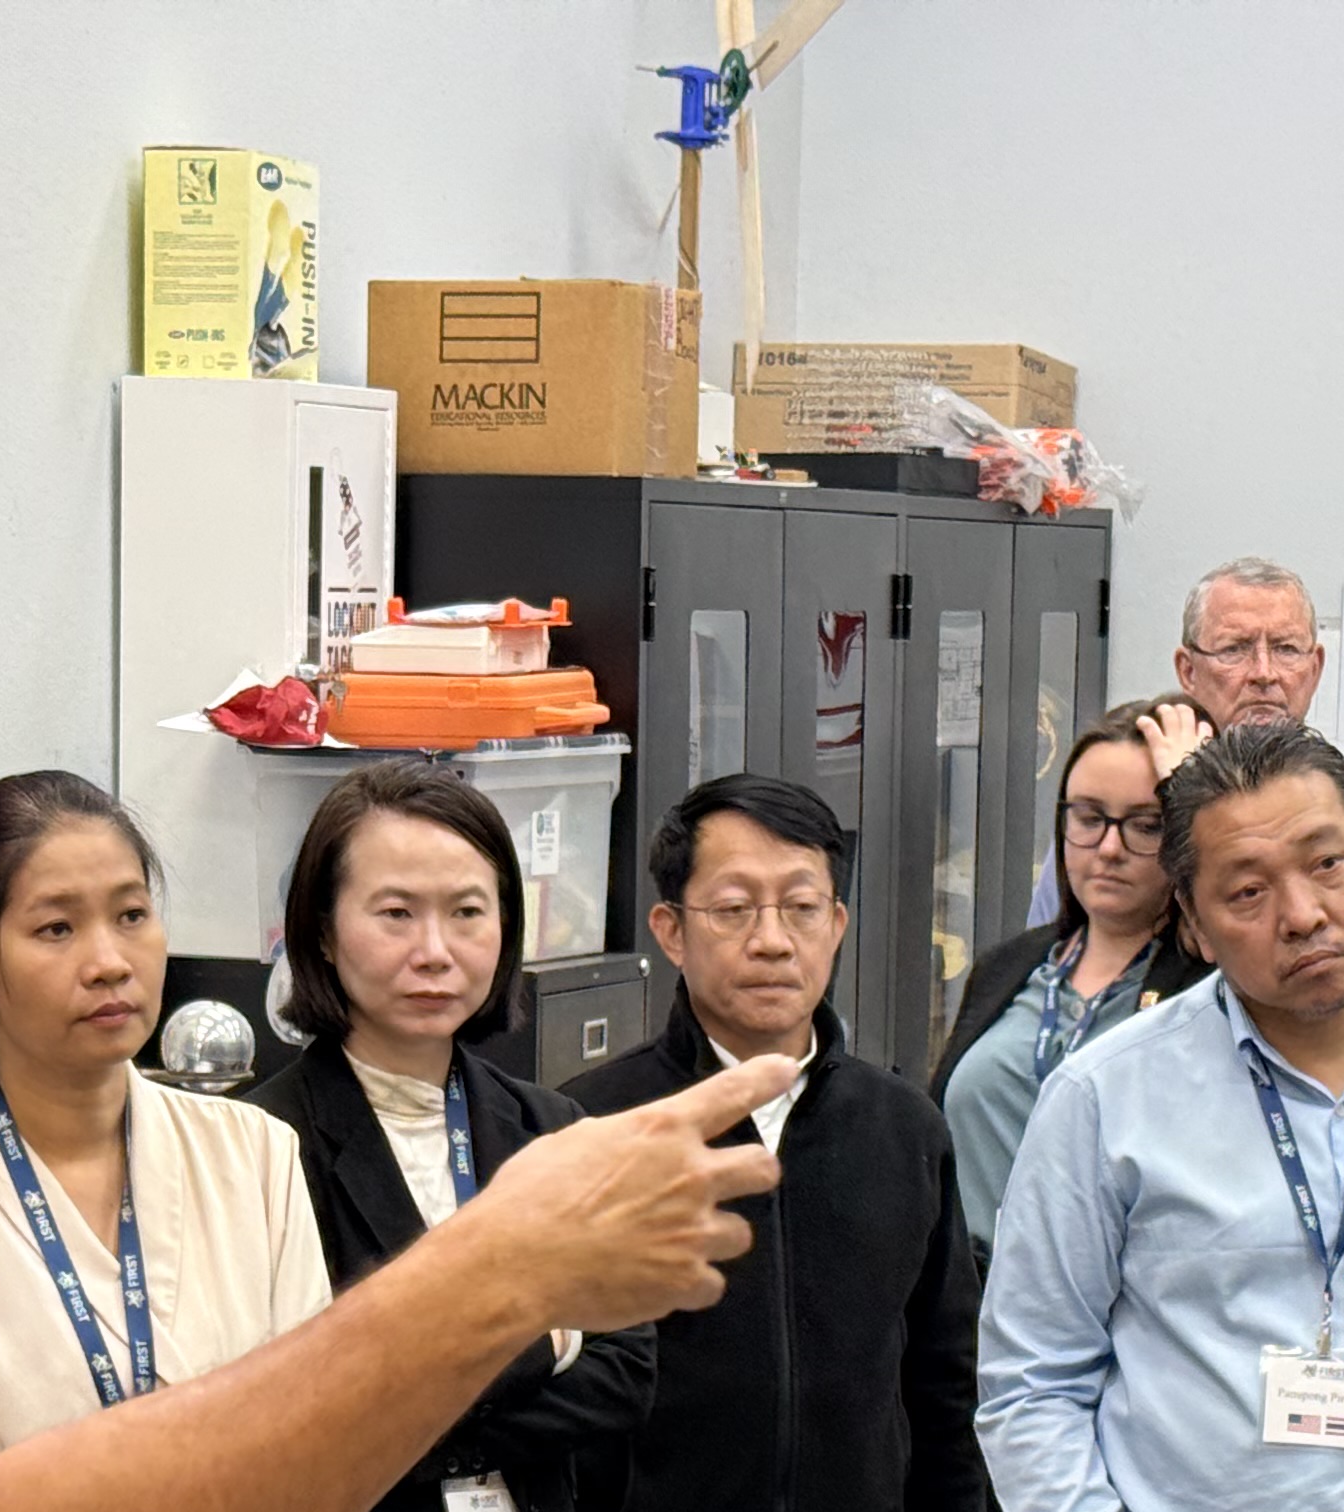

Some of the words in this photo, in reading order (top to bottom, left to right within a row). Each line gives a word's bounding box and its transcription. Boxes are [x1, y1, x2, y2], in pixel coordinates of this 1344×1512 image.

[301, 220, 316, 347] PUSH-IN
[432, 382, 547, 410] MACKIN
[1270, 1112, 1289, 1143] FIRST
[1, 1128, 23, 1162] FIRST
[32, 1207, 56, 1242] FIRST
[126, 1254, 138, 1288] FIRST
[67, 1289, 90, 1323] FIRST
[136, 1340, 148, 1377] FIRST
[100, 1372, 120, 1402] FIRS
